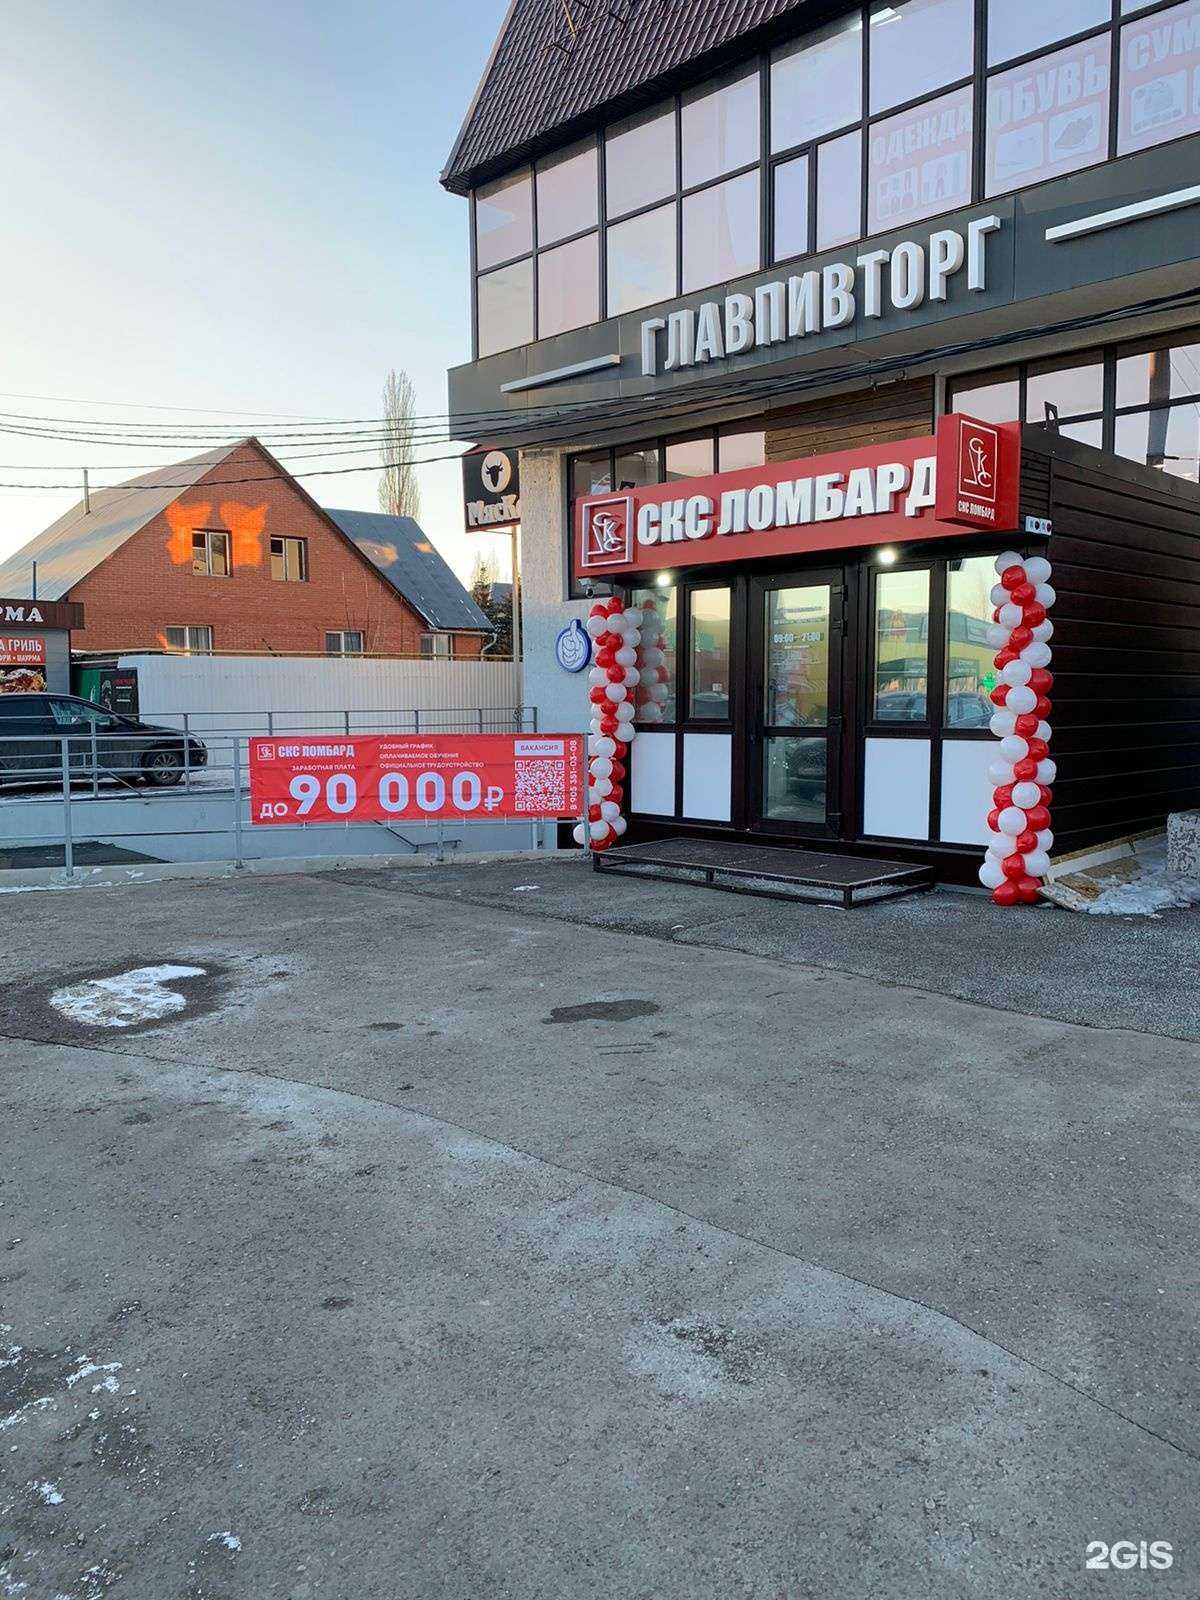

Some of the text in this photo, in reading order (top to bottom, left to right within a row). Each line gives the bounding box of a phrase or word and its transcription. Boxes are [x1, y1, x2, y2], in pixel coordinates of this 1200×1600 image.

[871, 107, 972, 164] ОДЕЖДА
[641, 215, 1000, 376] ГЛАВПИВТОРГ
[637, 455, 938, 546] СКС ЛОМБАРД
[958, 500, 996, 521] СКС ЛОМБАРД
[0, 606, 44, 622] МА
[8, 639, 42, 652] ГРИЛЬ
[278, 744, 355, 758] СКС ЛОМБАРД
[291, 763, 356, 772] ЗАРАБОТНАЯ ПЛАТА
[427, 761, 485, 769] ТРУДОУСТРОЙСТВО
[260, 802, 289, 819] ДО
[289, 773, 358, 815] 90
